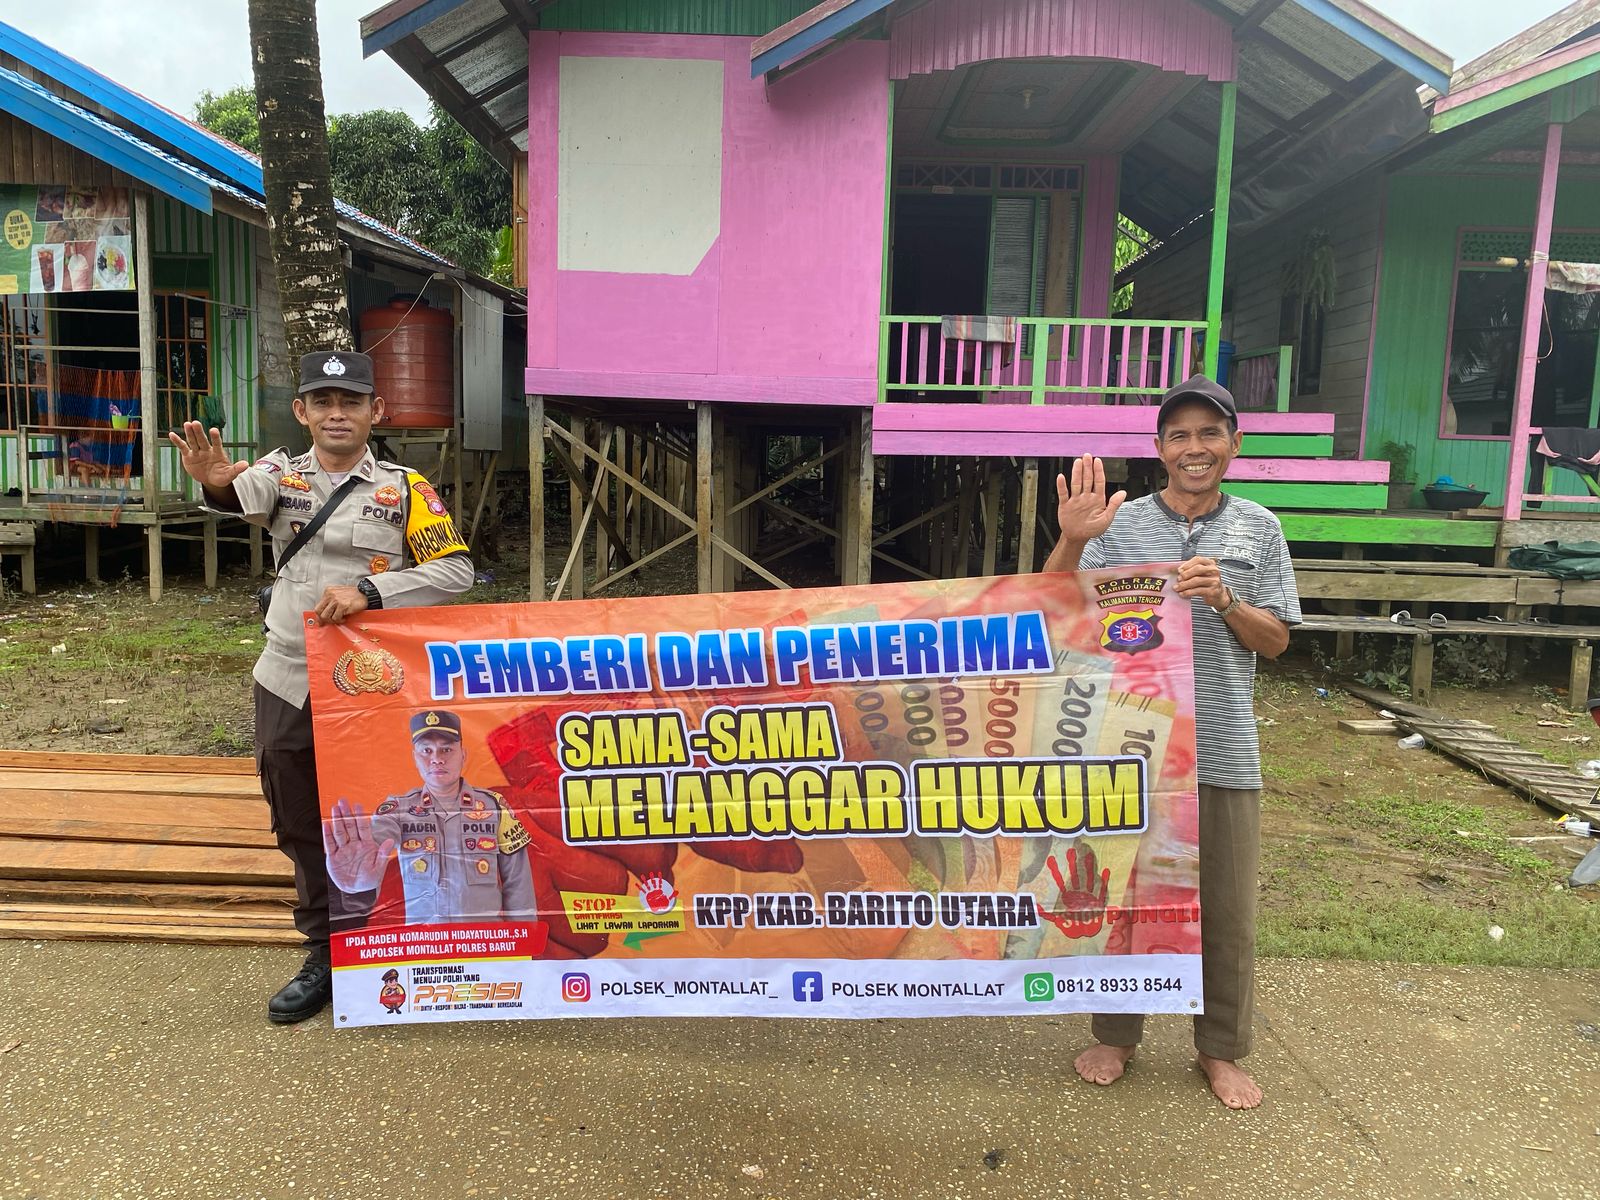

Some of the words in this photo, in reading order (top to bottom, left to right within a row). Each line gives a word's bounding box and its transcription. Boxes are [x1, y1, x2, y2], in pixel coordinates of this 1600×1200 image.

[279, 495, 312, 511] MBANG
[1098, 577, 1163, 591] POLRES
[1101, 584, 1132, 595] BARITO
[1133, 583, 1161, 591] UTARA
[1099, 596, 1137, 608] KALIMANTAN
[1138, 596, 1162, 605] TENGAH
[427, 632, 650, 698] PEMBERI
[656, 629, 767, 691] DAN
[774, 609, 1052, 684] PENERIMA
[560, 713, 690, 771] SAMA
[564, 767, 907, 842] MELANGGAR
[914, 760, 1143, 832] HUKUM
[402, 822, 437, 833] RADEN
[463, 823, 495, 833] POLRI
[573, 898, 616, 911] STOP
[695, 896, 750, 927] KPP
[754, 895, 822, 927] KAB.
[828, 894, 939, 927] BARITO
[941, 894, 1038, 927] UTARA
[1105, 902, 1199, 925] PUNGLI
[576, 922, 599, 930] LIHAT
[604, 921, 633, 930] LAWAN
[638, 920, 679, 929] LAPORKAN
[345, 936, 366, 947] IPDA
[368, 933, 398, 945] RADEN
[400, 931, 449, 943] KOMARUDIN
[360, 946, 404, 959] KAPOLSEK
[406, 943, 454, 956] MONTALLAT
[456, 942, 487, 954] POLRES
[489, 941, 516, 952] BARUT
[412, 965, 465, 975] TRANSFORMASI
[413, 975, 442, 984] MENUJU
[443, 974, 463, 983] POLRI
[464, 974, 480, 982] YANG
[1057, 979, 1096, 993] 0812
[1100, 978, 1139, 993] 8933
[1144, 978, 1183, 992] 8544
[413, 982, 523, 1004] PRESISI
[600, 981, 779, 999] POLSEK_MONTALLAT_
[832, 982, 899, 997] POLSEK
[904, 982, 1006, 997] MONTALLAT
